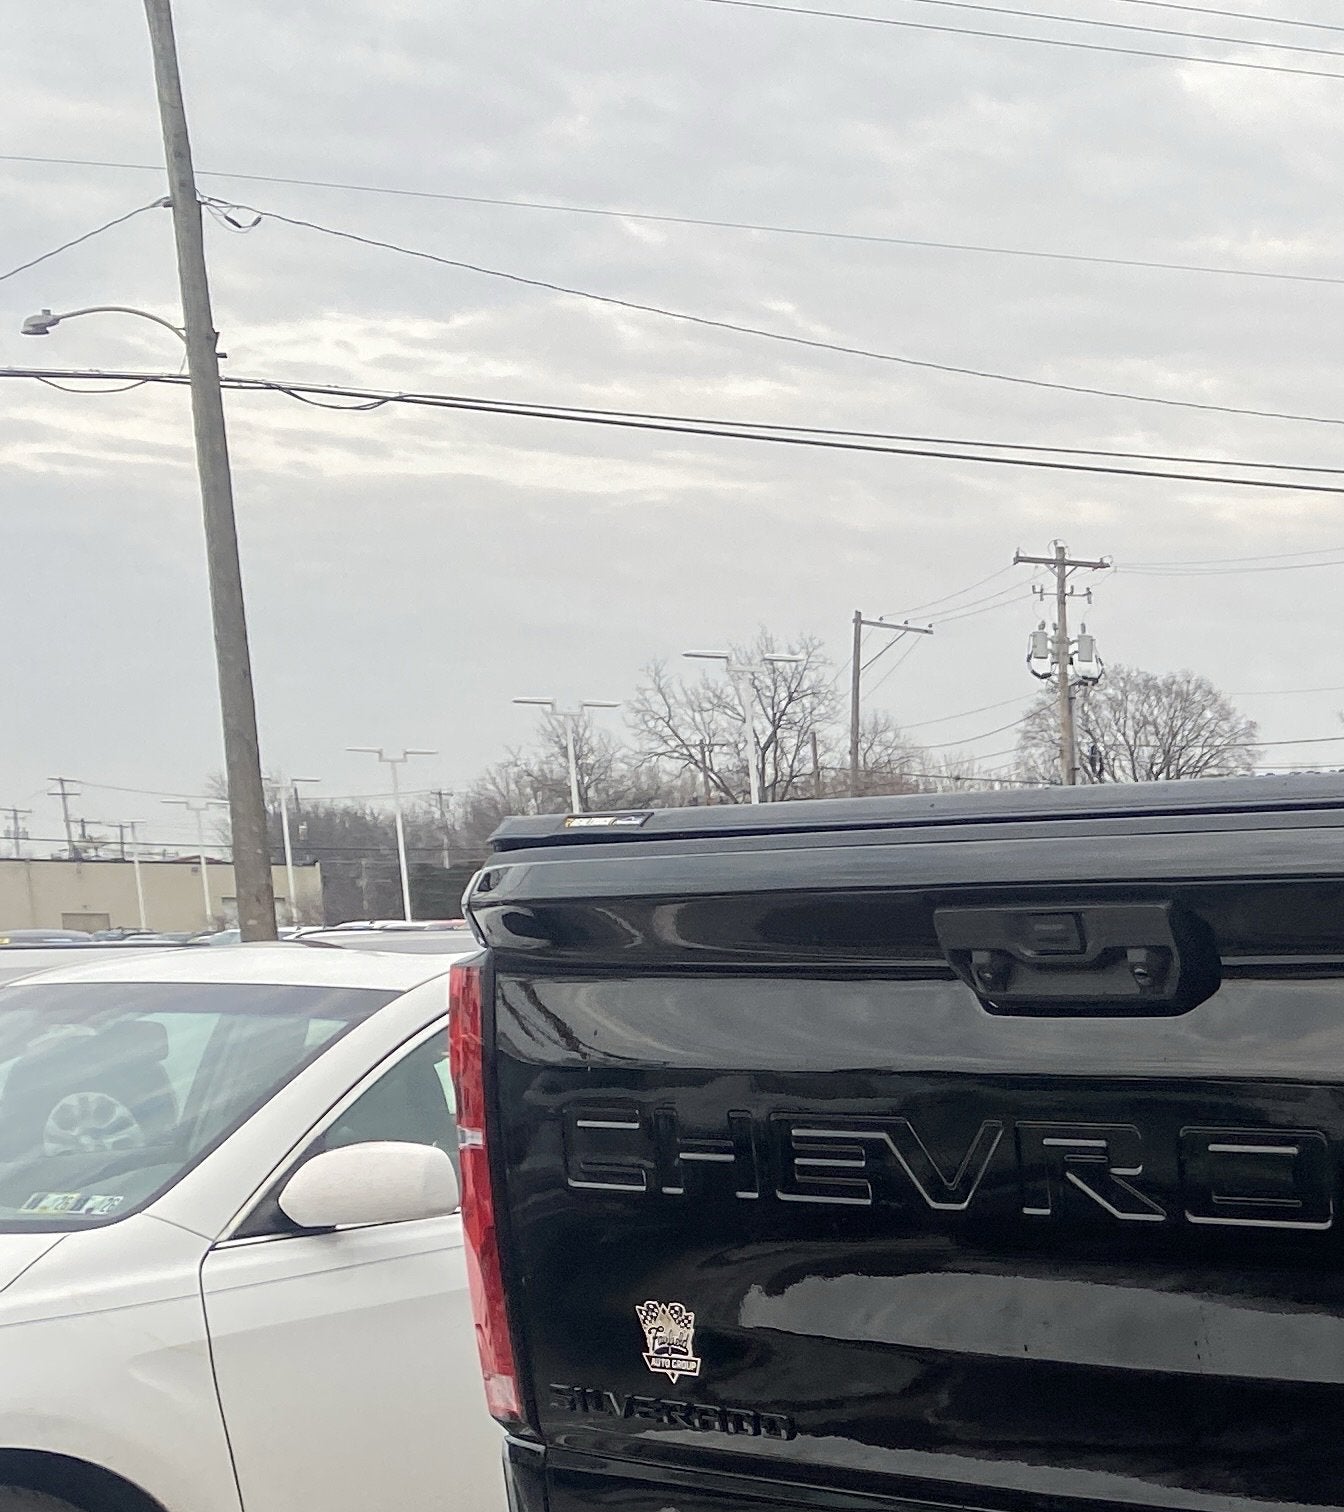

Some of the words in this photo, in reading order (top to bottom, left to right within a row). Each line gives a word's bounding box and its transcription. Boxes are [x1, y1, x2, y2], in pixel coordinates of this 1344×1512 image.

[651, 1357, 671, 1369] AUTO
[671, 1358, 697, 1372] GROUP
[549, 1384, 798, 1440] SILVERADO
